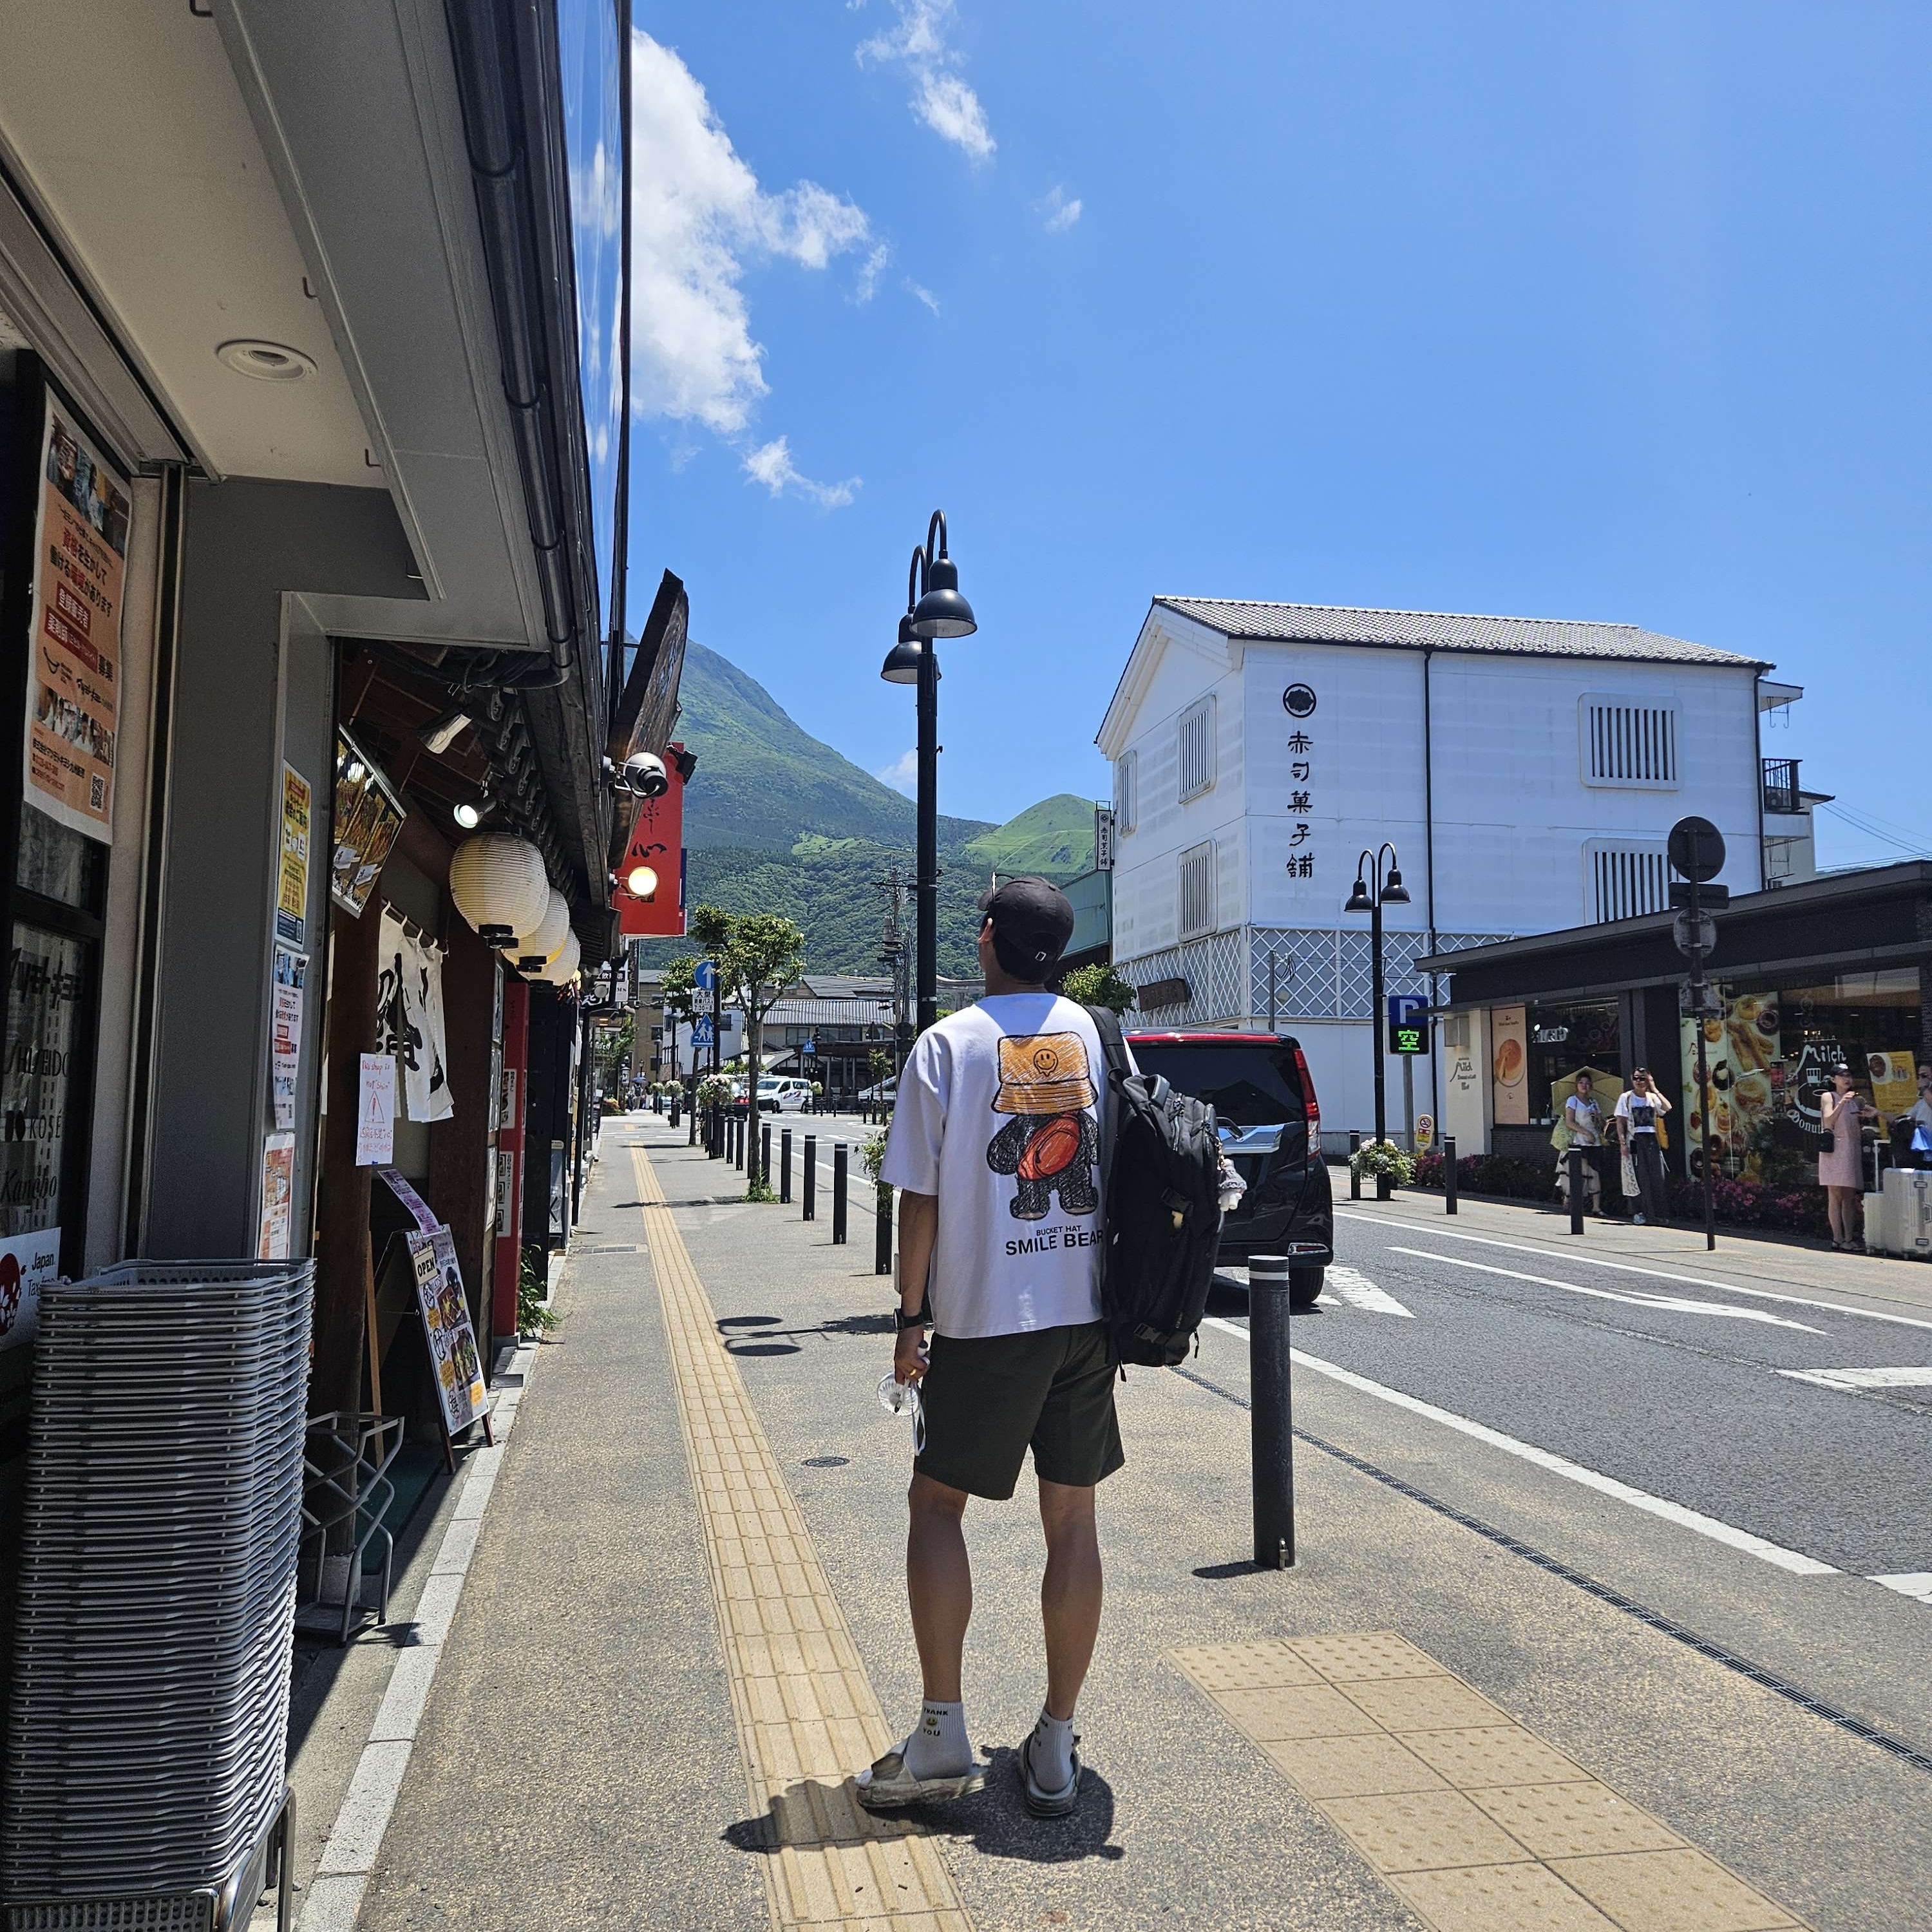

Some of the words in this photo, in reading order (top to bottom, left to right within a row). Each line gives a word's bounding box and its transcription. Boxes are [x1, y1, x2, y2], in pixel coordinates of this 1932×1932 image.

[1399, 999, 1419, 1024] P
[1398, 1030, 1420, 1051] 空
[1036, 1226, 1063, 1236] BUCKET
[1005, 1235, 1057, 1256] SMILE
[1064, 1230, 1103, 1247] BEAR
[417, 1256, 435, 1278] OPEN
[923, 1728, 940, 1736] YOU
